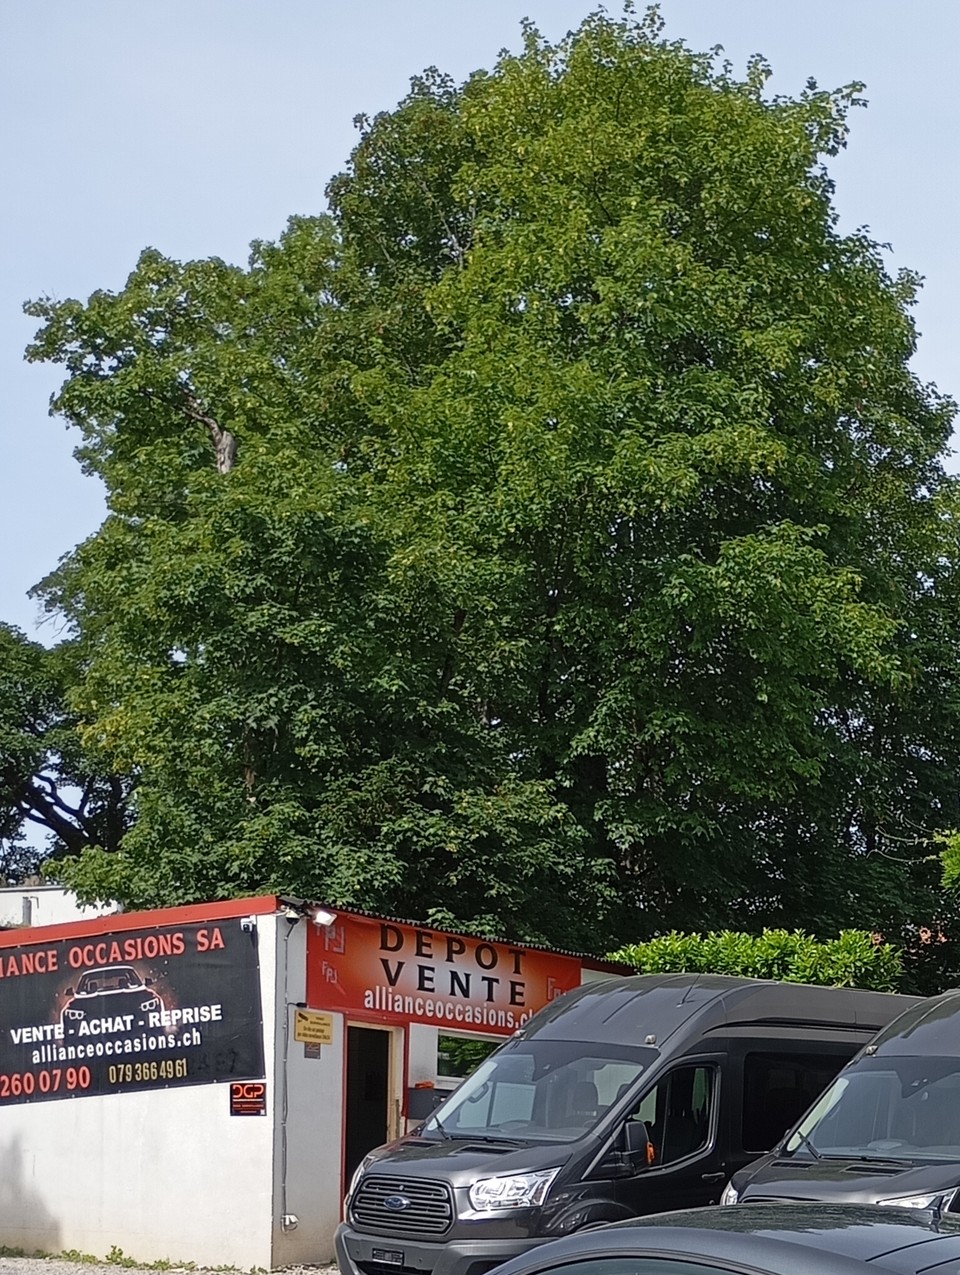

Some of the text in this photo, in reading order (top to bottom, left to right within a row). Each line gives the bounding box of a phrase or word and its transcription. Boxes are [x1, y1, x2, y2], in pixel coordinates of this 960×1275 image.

[69, 932, 185, 968] OCCASIONS
[196, 927, 225, 952] SA
[379, 923, 527, 975] DEPOT
[379, 957, 526, 1007] VENTE
[10, 1023, 65, 1045] VENTE
[78, 1015, 135, 1037] ACHAT
[148, 1004, 223, 1029] REPRISE
[32, 1027, 202, 1064] allianceoccasions.ch
